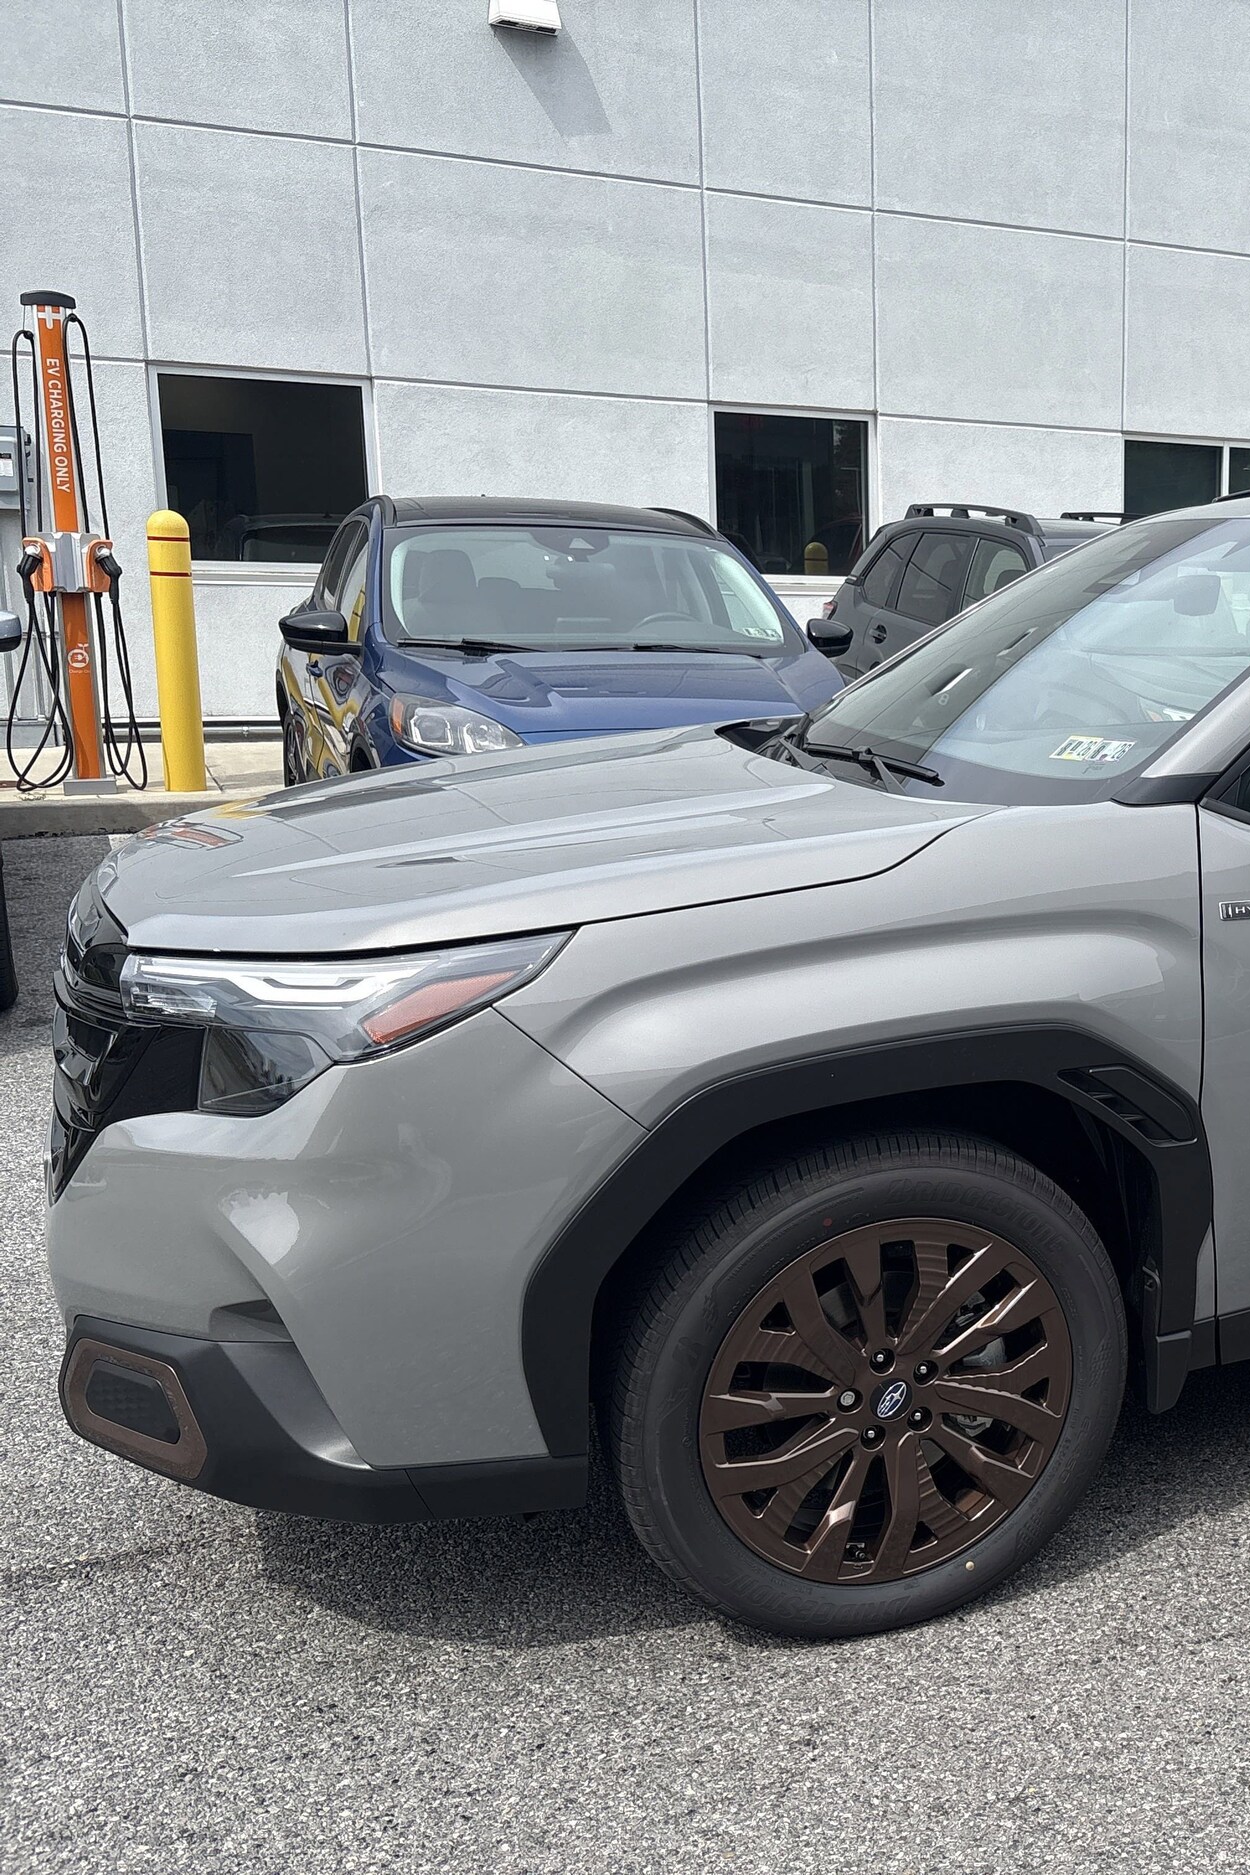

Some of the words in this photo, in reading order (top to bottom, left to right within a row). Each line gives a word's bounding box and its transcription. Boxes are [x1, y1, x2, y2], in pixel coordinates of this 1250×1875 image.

[46, 358, 61, 377] EV
[48, 379, 67, 453] CHARGING
[54, 455, 71, 494] ONLY
